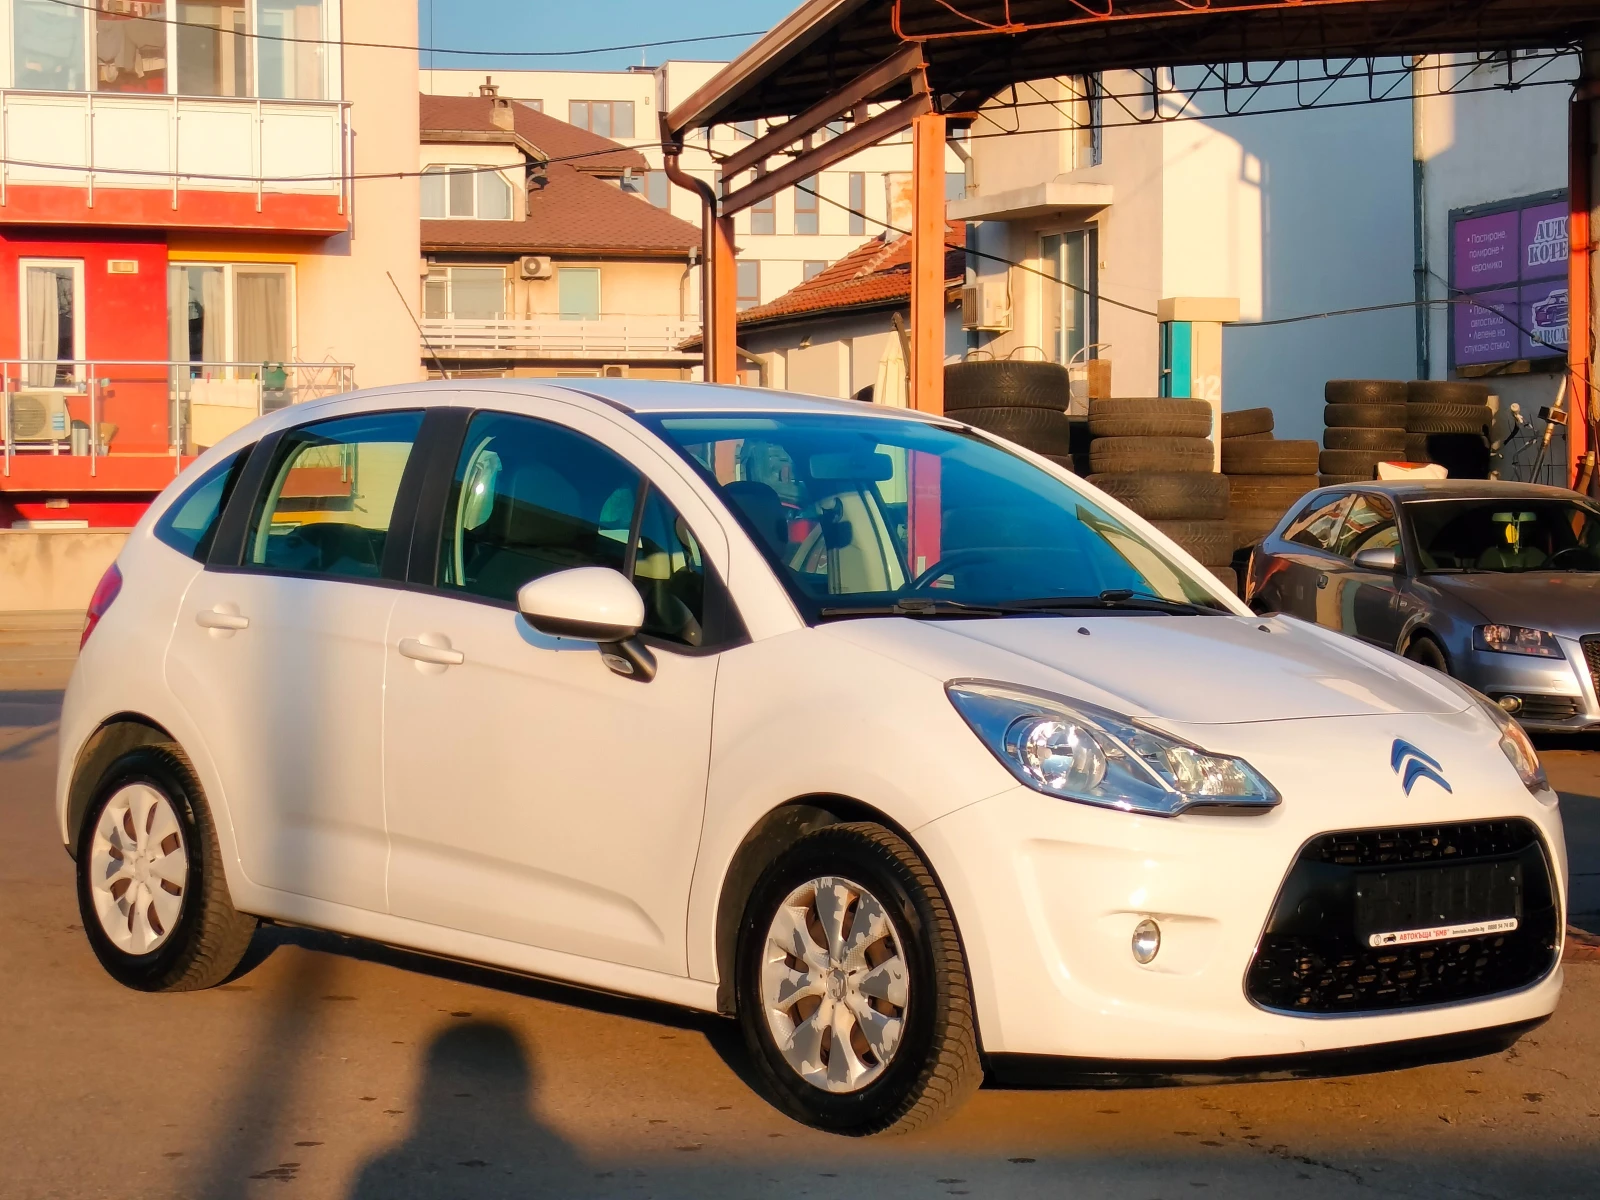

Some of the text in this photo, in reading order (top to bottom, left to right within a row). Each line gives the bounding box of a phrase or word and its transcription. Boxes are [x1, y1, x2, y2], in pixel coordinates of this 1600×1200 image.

[1471, 260, 1503, 273] керамика
[1193, 375, 1221, 401] 12
[1399, 931, 1431, 941] АВТОКЪЩА
